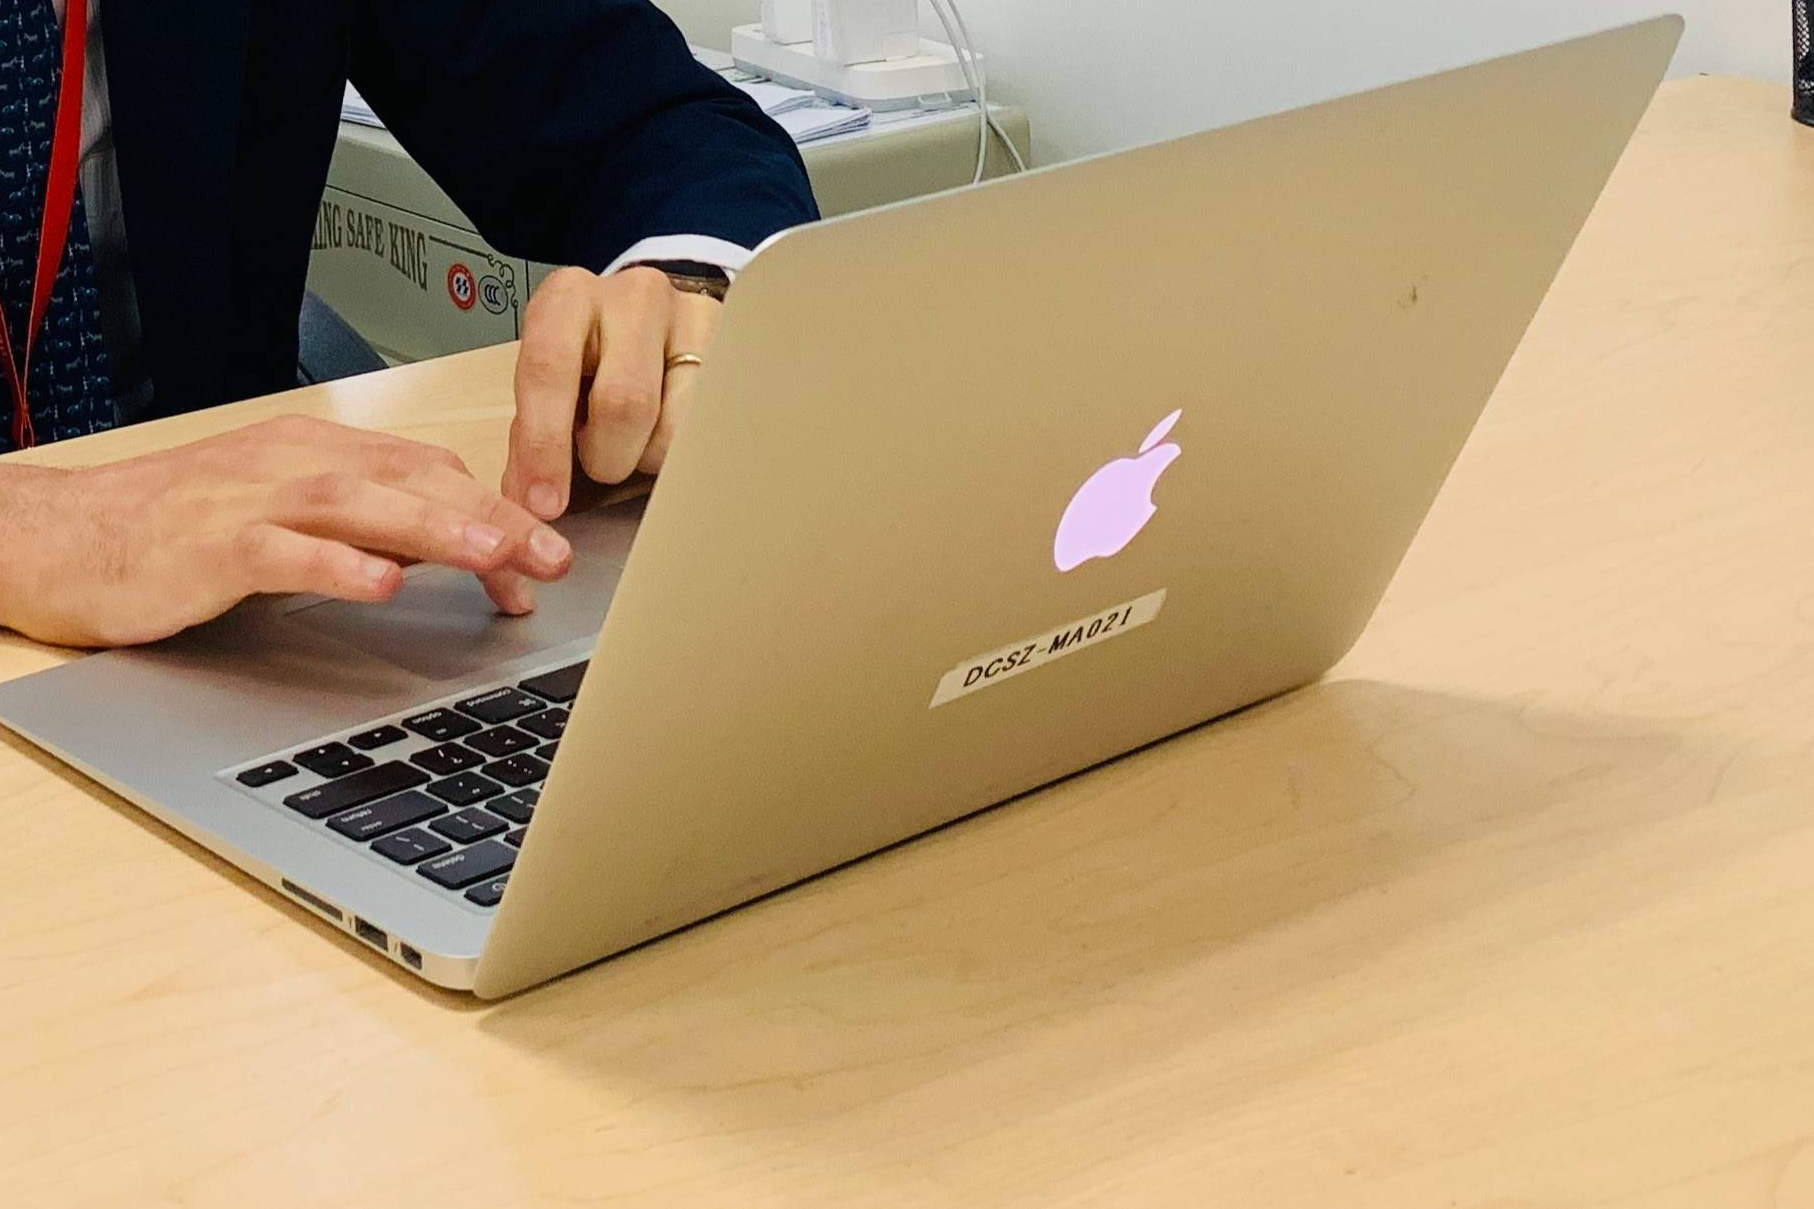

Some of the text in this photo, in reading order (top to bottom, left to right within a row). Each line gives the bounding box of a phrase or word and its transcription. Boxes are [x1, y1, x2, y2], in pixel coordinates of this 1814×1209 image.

[347, 208, 384, 258] SAFE
[388, 222, 427, 292] KING
[961, 605, 1134, 689] DCSZ-MA021
